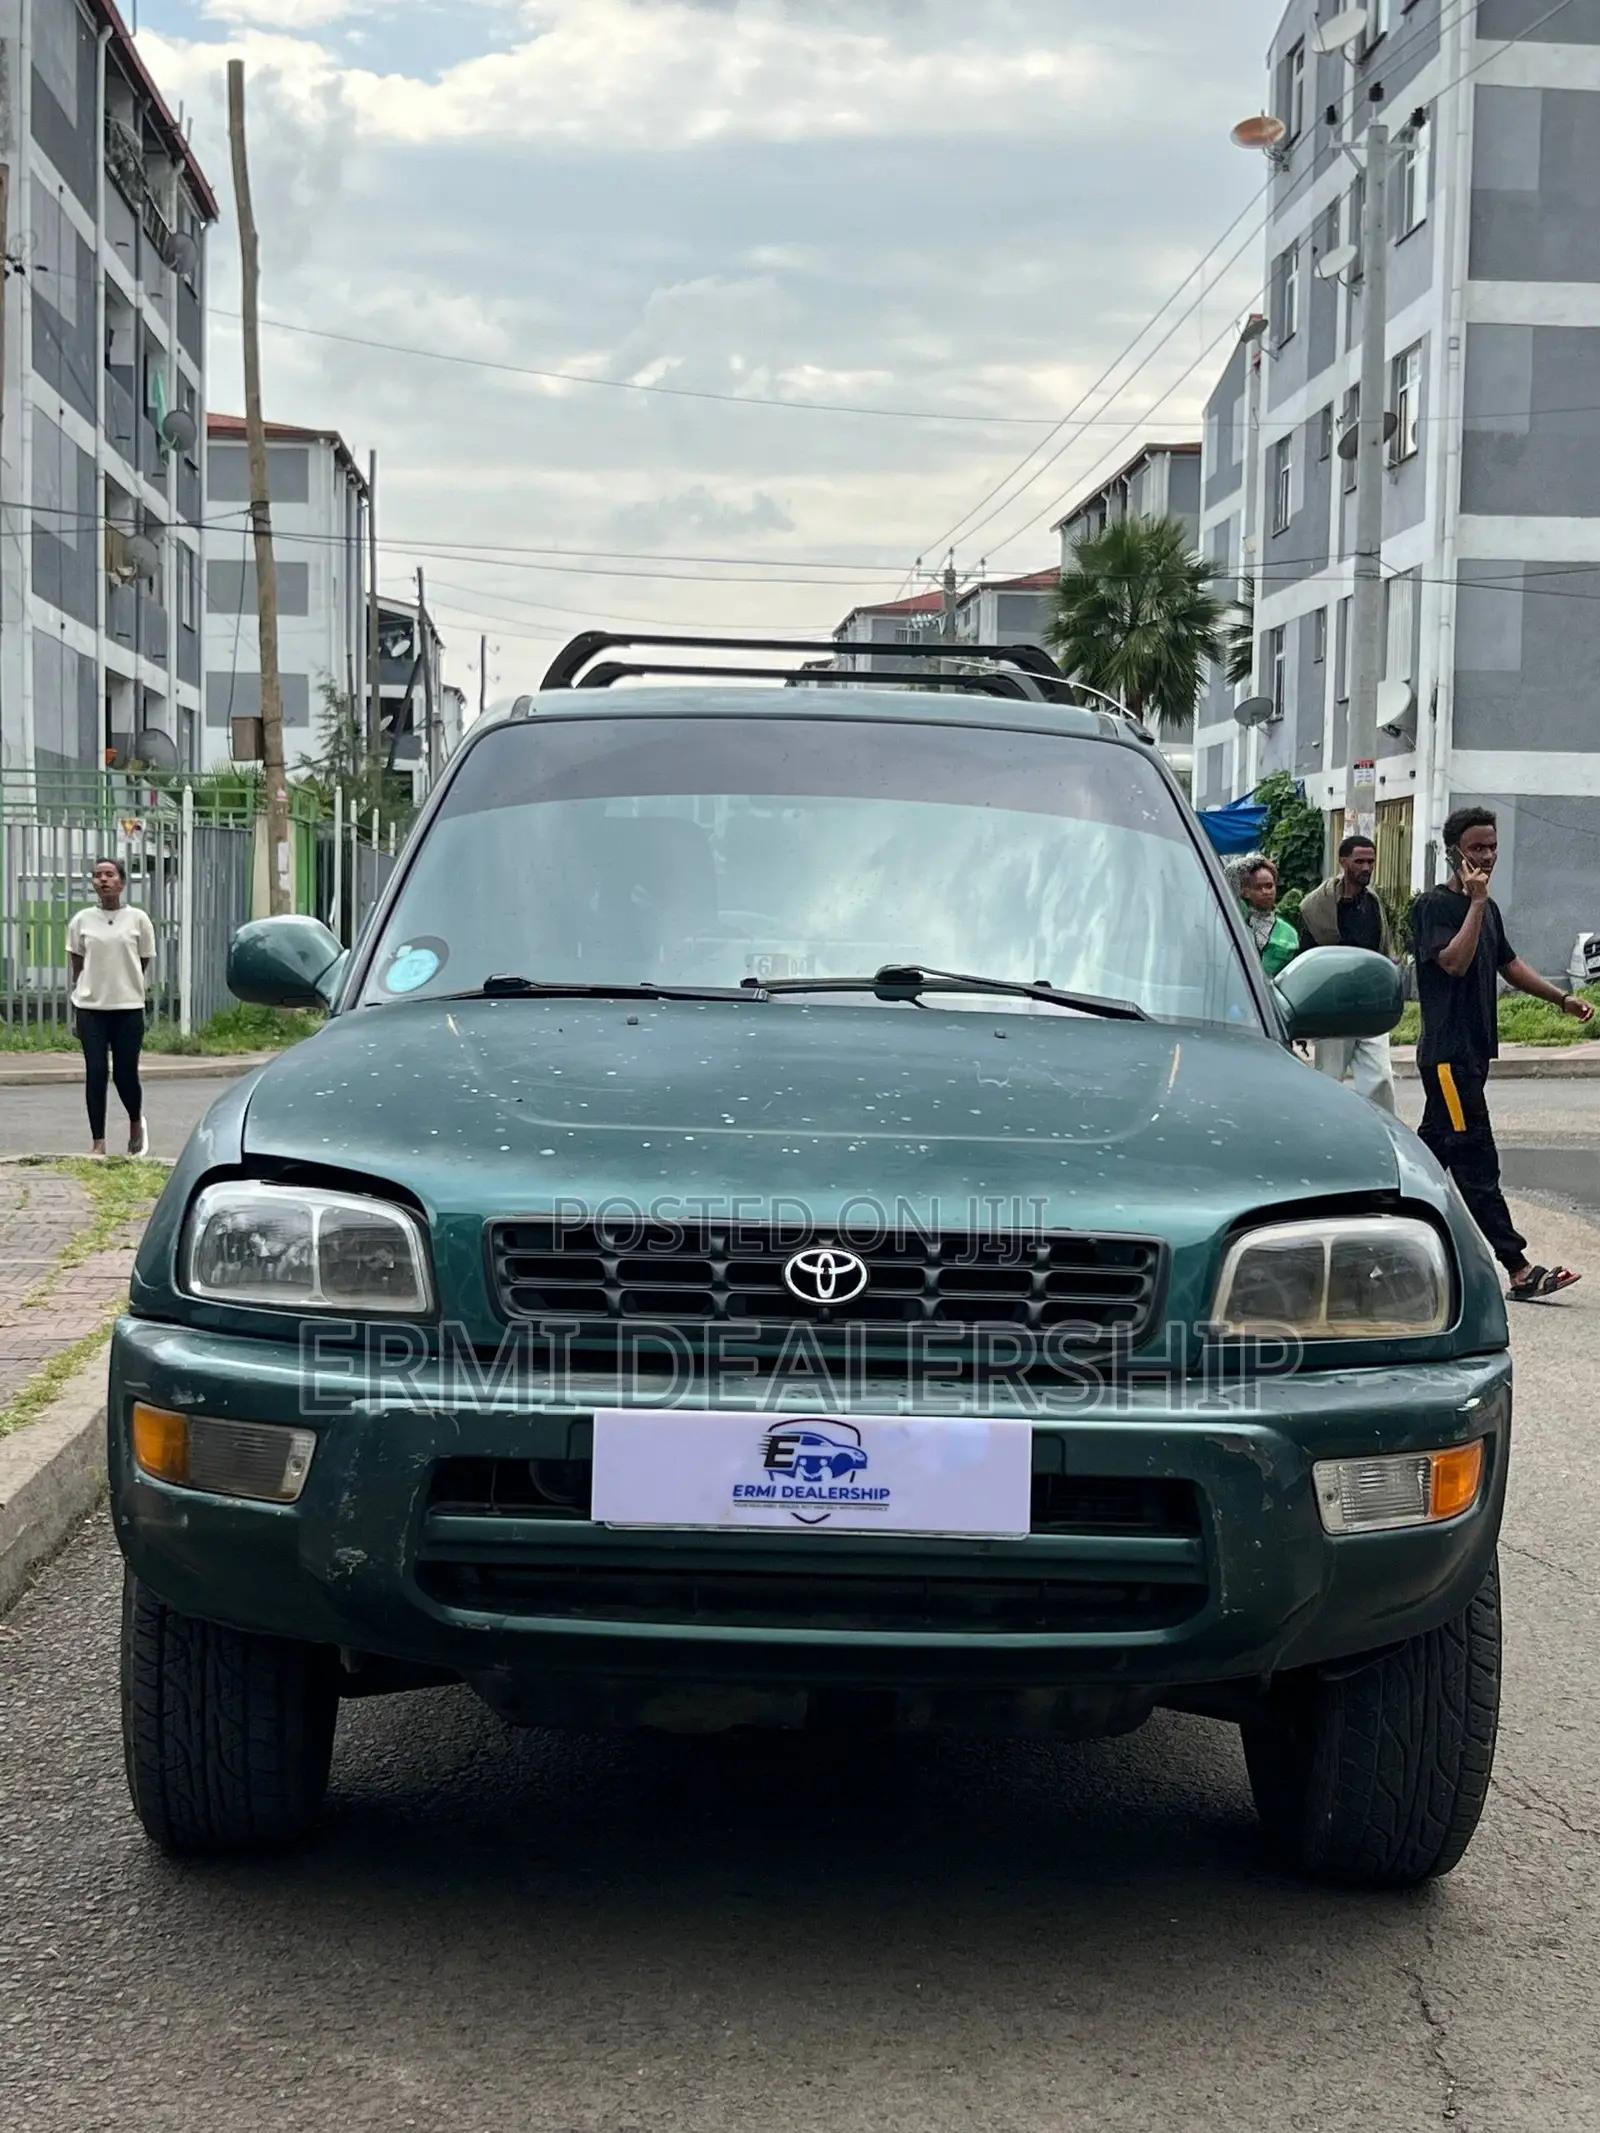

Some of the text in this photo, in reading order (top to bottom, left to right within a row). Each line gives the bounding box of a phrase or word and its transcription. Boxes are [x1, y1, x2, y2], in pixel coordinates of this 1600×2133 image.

[762, 1434, 801, 1468] E
[733, 1484, 891, 1501] ERMI DEALERSHIP
